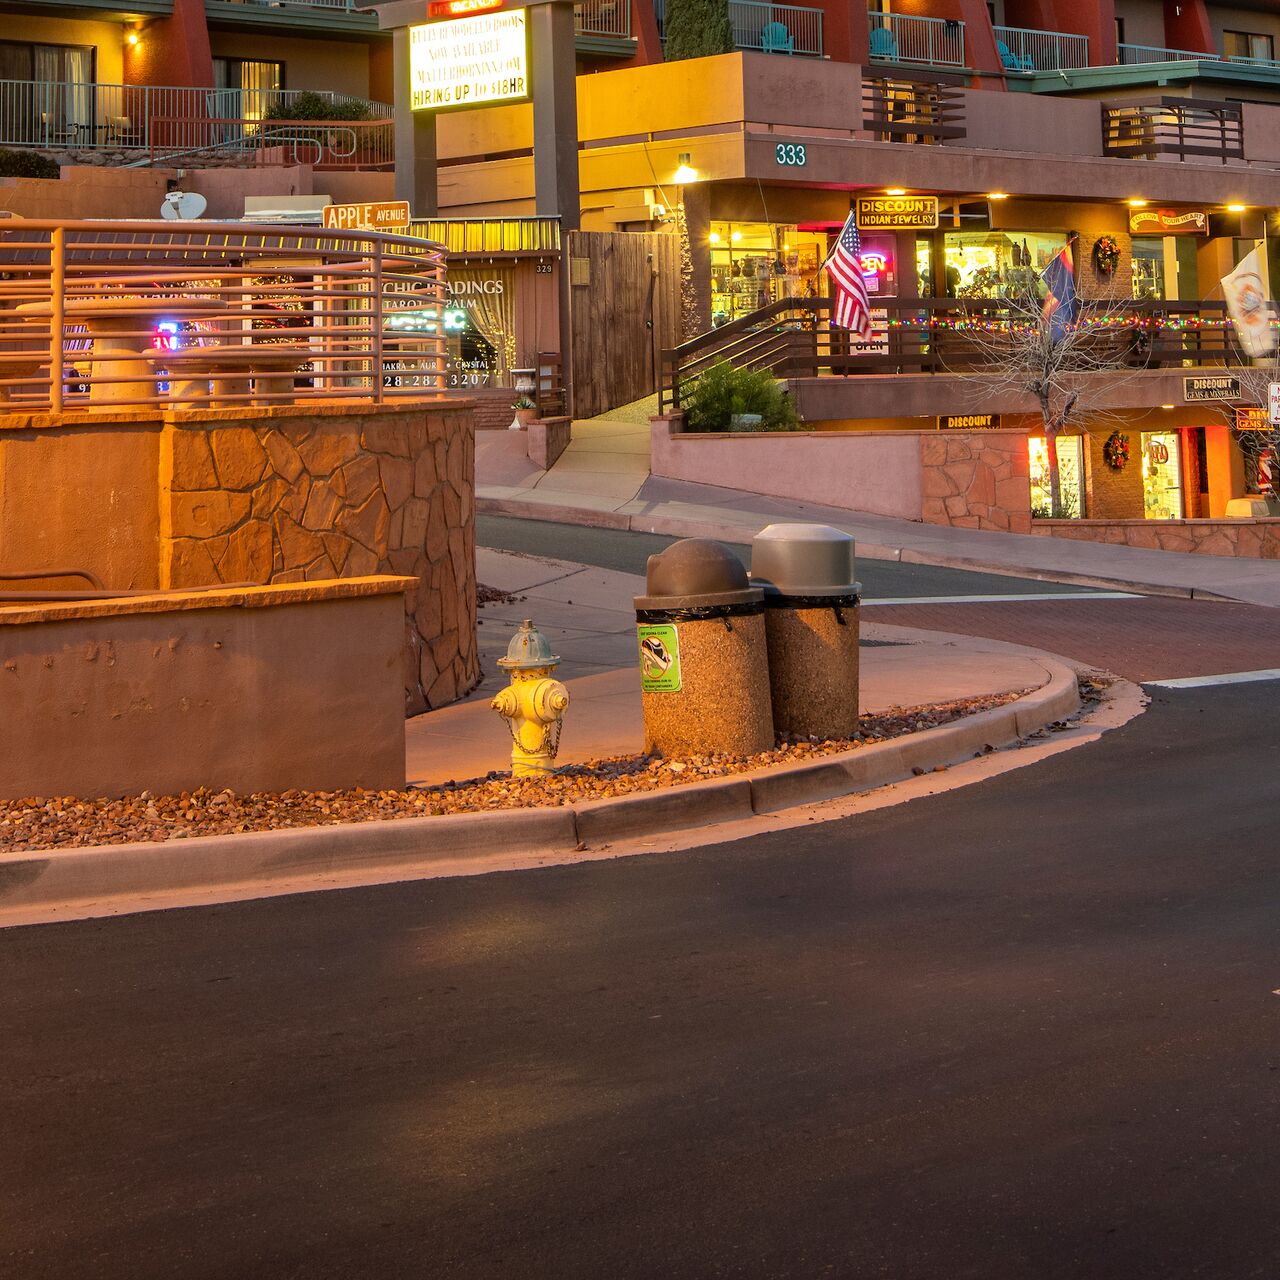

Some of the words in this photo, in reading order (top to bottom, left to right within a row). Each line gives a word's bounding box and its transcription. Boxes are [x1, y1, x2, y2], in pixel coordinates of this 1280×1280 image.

[413, 86, 451, 106] HIRING
[455, 84, 470, 100] UP
[776, 143, 806, 166] 333
[861, 200, 935, 213] DISCOUNT
[327, 206, 373, 229] APPLE
[376, 209, 406, 222] AVENUE
[861, 214, 891, 225] INDIAN
[892, 214, 935, 225] JEWELRY
[1132, 213, 1157, 223] FOLLOW
[1163, 216, 1180, 224] YOUR
[1180, 213, 1203, 223] HEART
[536, 265, 552, 273] 329
[427, 280, 504, 295] ADINGS
[420, 360, 437, 370] AUR
[455, 360, 490, 370] CRYSTAL
[1193, 379, 1233, 390] DISCOUNT
[1187, 391, 1204, 400] GEMS
[947, 415, 993, 428] DISCOUNT
[1239, 420, 1262, 428] GEMS
